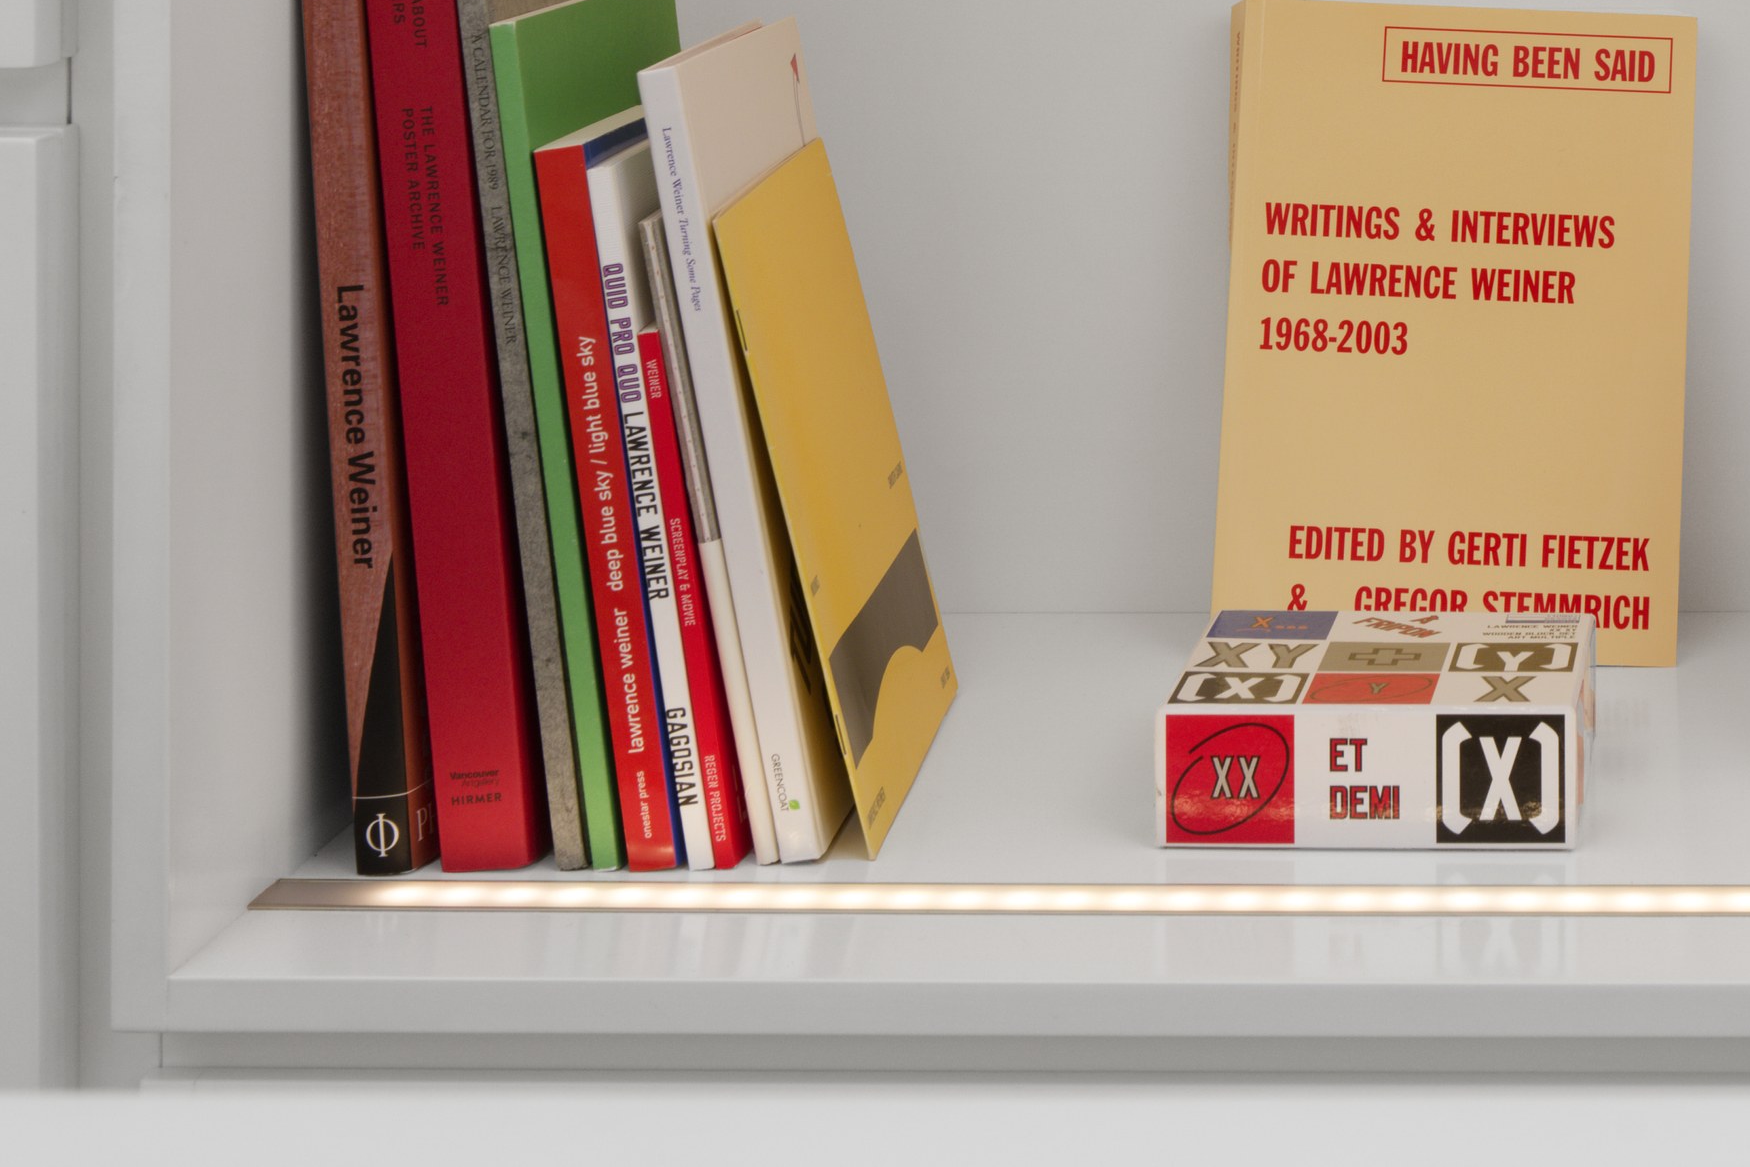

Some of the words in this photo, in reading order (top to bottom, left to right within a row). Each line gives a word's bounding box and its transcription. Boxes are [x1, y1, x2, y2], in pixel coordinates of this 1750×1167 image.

[1401, 40, 1499, 77] HAVING
[1512, 45, 1581, 80] BEEN
[1594, 48, 1656, 83] SAID
[473, 47, 492, 127] CALENDAR
[401, 108, 418, 173] POSTER
[420, 106, 435, 135] THE
[483, 132, 497, 161] FOR
[662, 127, 677, 176] Lawrence
[423, 145, 443, 234] LAWRENCE
[485, 164, 498, 190] 1989
[672, 178, 685, 215] Weiner
[407, 179, 425, 251] ARCHIVE
[1265, 201, 1400, 241] WRITINGS
[1415, 208, 1435, 242] &
[1450, 209, 1616, 249] INTERVIEWS
[491, 206, 512, 283] LAWRENCE
[678, 218, 692, 257] Turning
[432, 241, 449, 306] WEINER
[602, 263, 629, 309] QUID
[686, 258, 696, 283] Some
[1261, 258, 1298, 293] OF
[1310, 260, 1458, 300] LAWRENCE
[1471, 267, 1576, 304] WEINER
[500, 289, 517, 345] WEINER
[690, 286, 701, 311] Pages
[576, 336, 596, 367] sky
[610, 317, 635, 356] PRO
[1259, 316, 1409, 356] 1968-2003
[337, 285, 366, 444] Lawrence
[617, 363, 642, 404] QUO
[646, 359, 662, 399] WEINER
[582, 371, 600, 410] blue
[586, 414, 608, 454] light
[594, 470, 614, 501] sky
[624, 411, 658, 517] LAWRENCE
[348, 451, 377, 569] Weiner
[600, 506, 618, 545] blue
[606, 548, 624, 592] deep
[640, 525, 669, 600] WEINER
[1288, 525, 1385, 562] EDITED
[1399, 529, 1435, 563] BY
[1447, 530, 1528, 567] GERTI
[1541, 534, 1650, 572] FIETZEK
[670, 518, 689, 580] SCREENPLAY
[681, 594, 696, 627] MOVIE
[1354, 585, 1468, 613] GREGOR
[1482, 590, 1650, 630] STEMMRICH
[613, 608, 634, 669] weiner
[1473, 676, 1535, 703] X
[624, 673, 645, 754] lawrence
[450, 769, 499, 780] Vancouver
[666, 707, 699, 807] GAGOSIAN
[704, 755, 719, 789] REGEN
[1329, 737, 1368, 773] ET
[635, 771, 649, 798] press
[771, 753, 790, 812] GREENCOAT
[1210, 755, 1260, 800] XX
[451, 793, 502, 806] HIRMER
[638, 799, 652, 839] onestar
[710, 790, 726, 842] PROJECTS
[1329, 785, 1400, 820] DEMI
